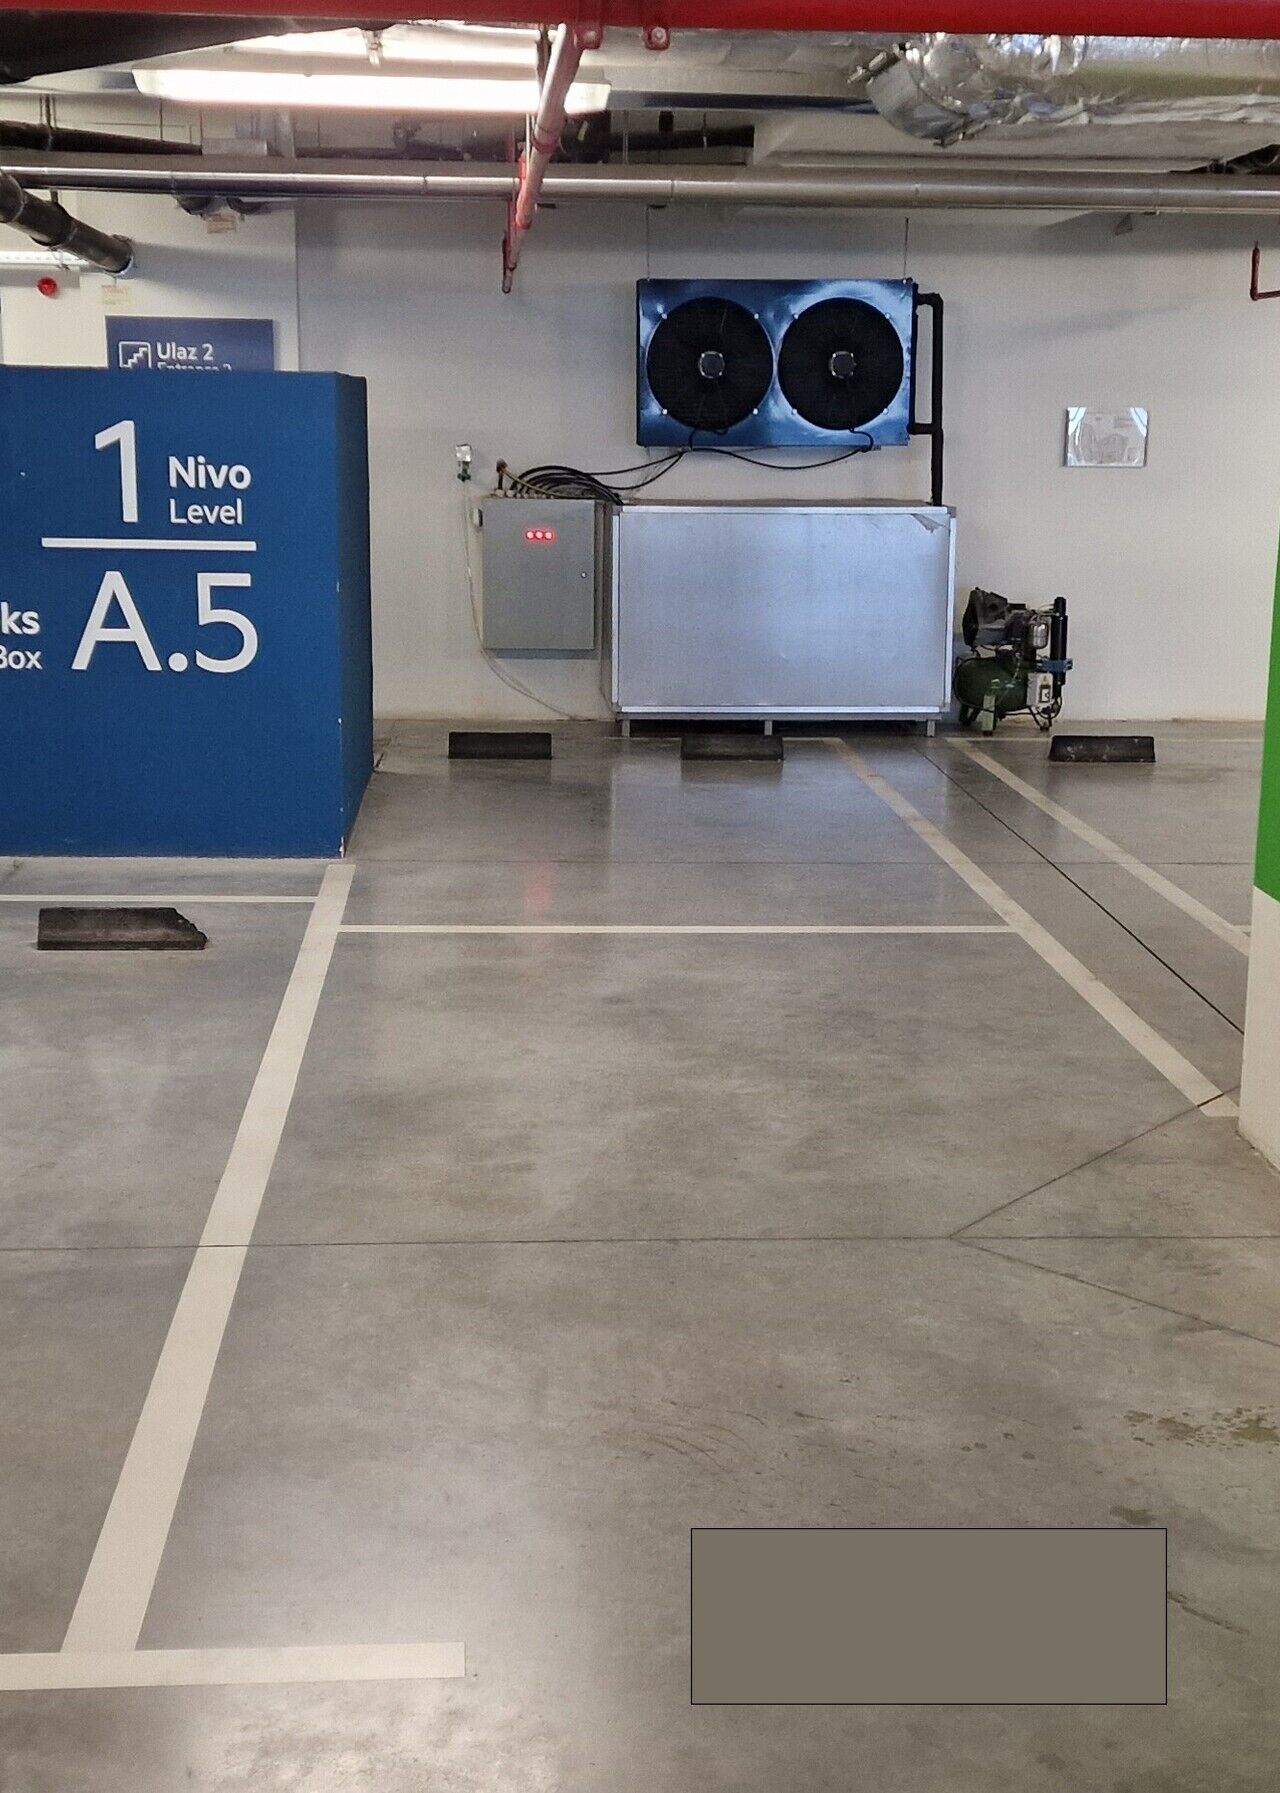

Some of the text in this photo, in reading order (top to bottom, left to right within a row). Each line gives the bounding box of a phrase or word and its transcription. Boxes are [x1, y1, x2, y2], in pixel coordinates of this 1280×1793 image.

[157, 342, 214, 361] Ulaz 2
[94, 420, 138, 523] 1
[168, 455, 252, 490] Nivo
[170, 498, 243, 525] Level
[71, 570, 258, 674] A.5
